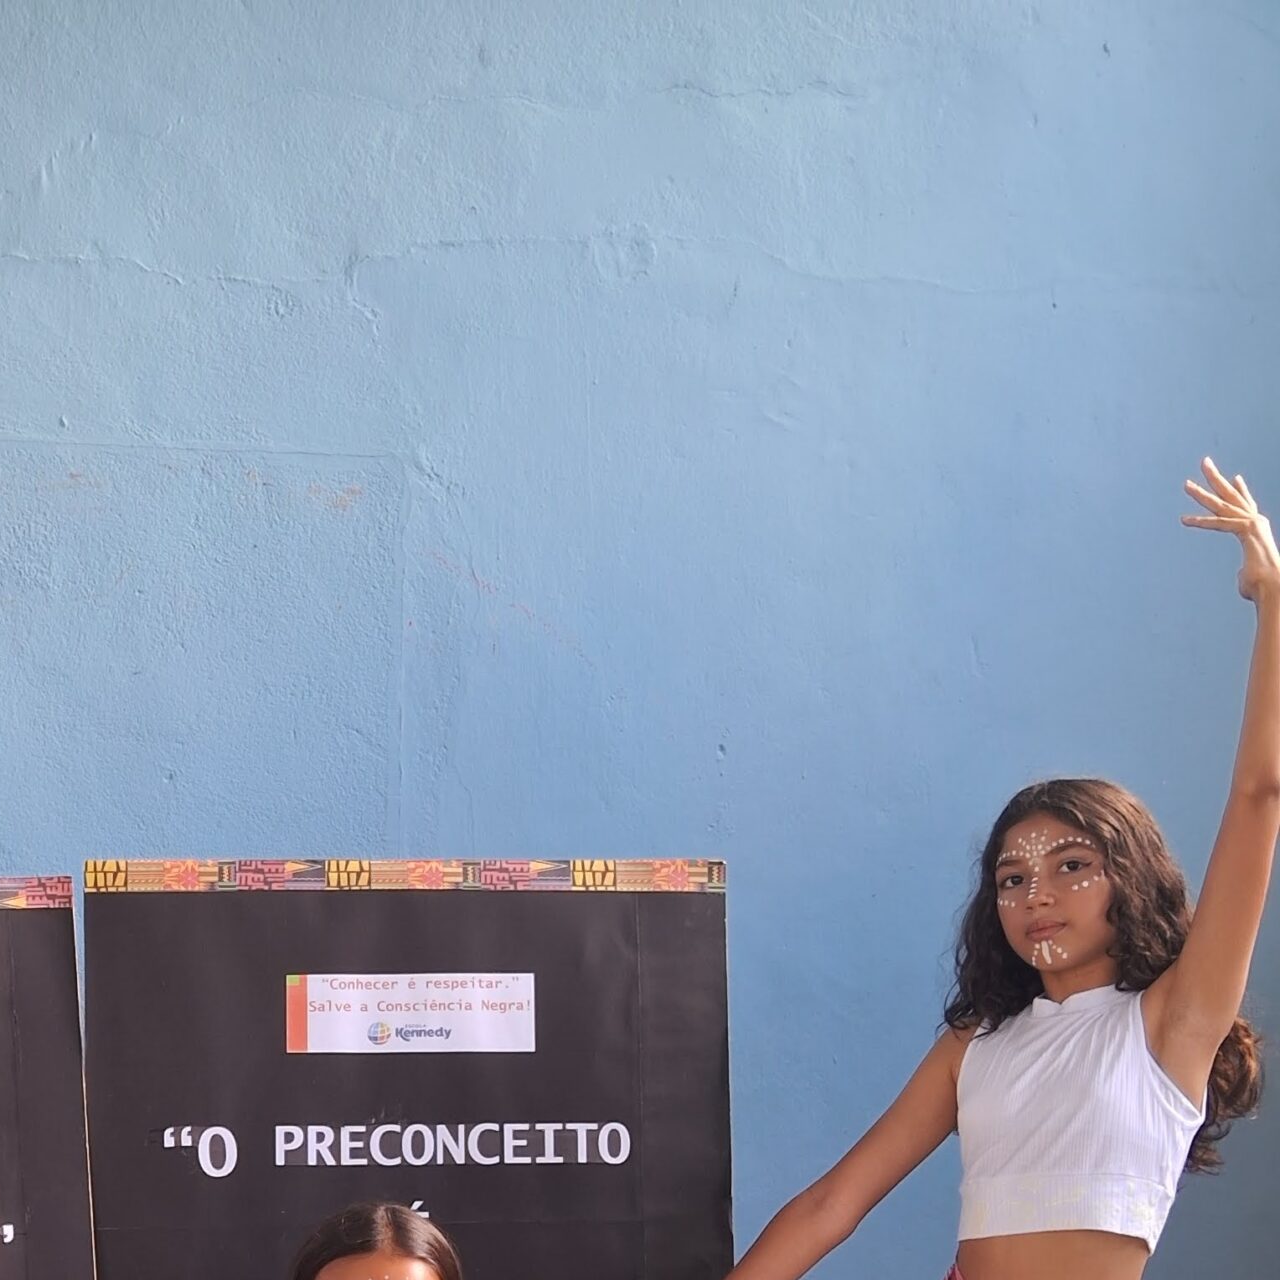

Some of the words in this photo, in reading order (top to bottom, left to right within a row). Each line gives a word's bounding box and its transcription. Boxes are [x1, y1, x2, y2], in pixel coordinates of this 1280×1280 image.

[407, 977, 417, 990] é
[308, 1000, 352, 1013] Salve
[359, 1002, 369, 1013] a
[376, 999, 473, 1012] Consciência
[480, 999, 532, 1014] Negra!
[395, 1026, 452, 1043] Kennedy
[273, 1121, 632, 1167] PRECONCEITO
